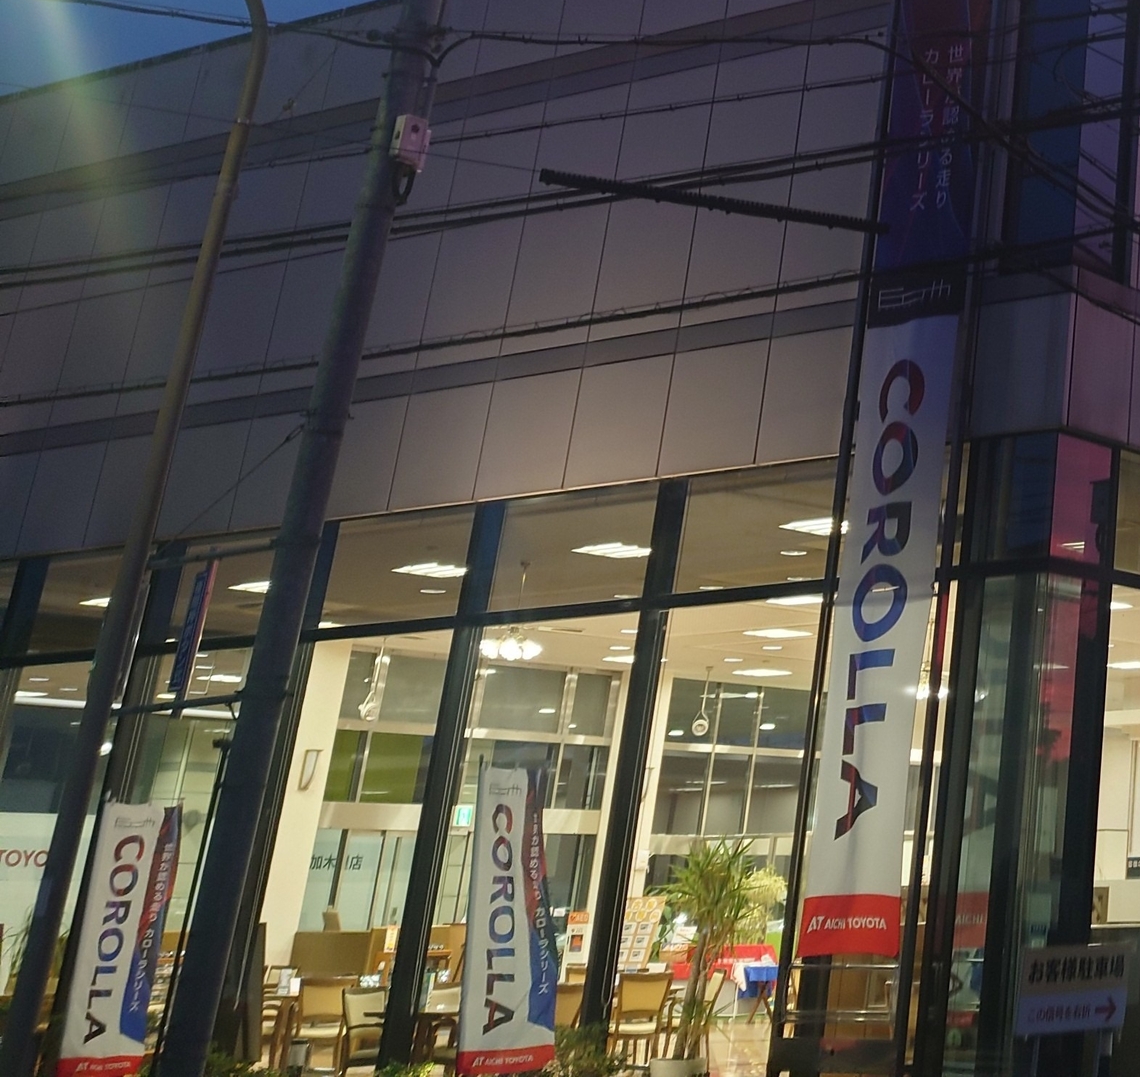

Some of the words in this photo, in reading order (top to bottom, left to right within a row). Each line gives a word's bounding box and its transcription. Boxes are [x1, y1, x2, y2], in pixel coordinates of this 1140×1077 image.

[834, 359, 925, 840] COROLLA
[309, 853, 364, 871] 加木店
[483, 803, 515, 1036] COROLLA
[83, 834, 145, 1045] COROLLA
[806, 915, 825, 934] AT
[824, 918, 846, 930] AICHI
[847, 917, 887, 930] TOYOTA
[505, 1054, 534, 1065] TOYOTA
